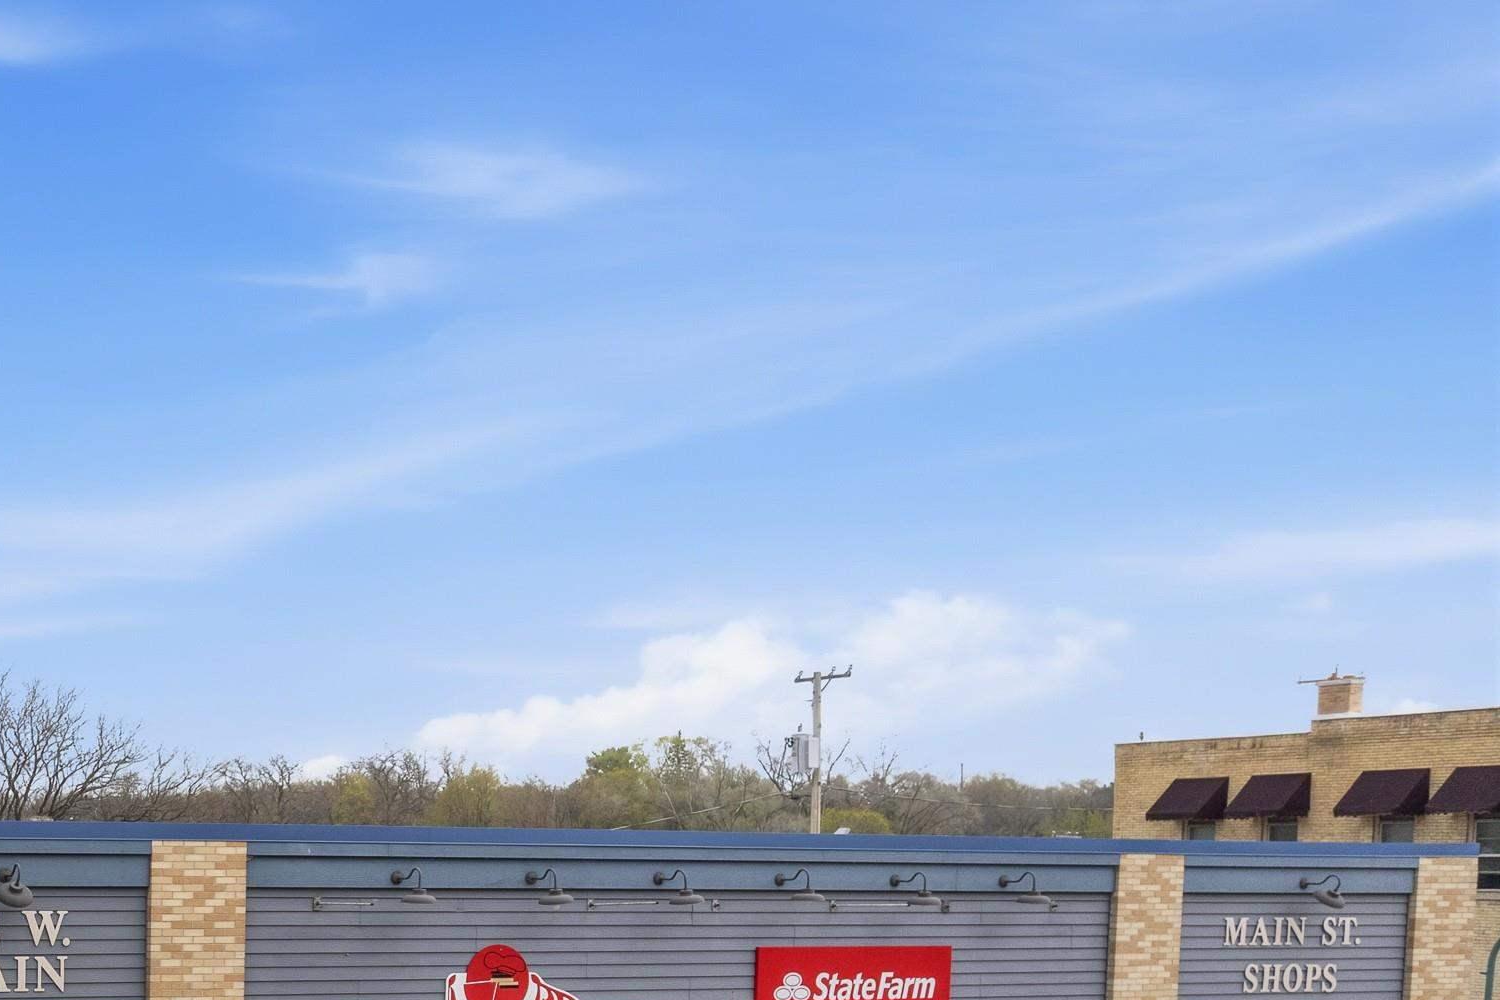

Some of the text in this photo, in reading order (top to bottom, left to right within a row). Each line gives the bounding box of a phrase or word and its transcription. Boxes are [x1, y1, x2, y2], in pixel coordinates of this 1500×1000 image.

[21, 910, 71, 947] W.
[1222, 916, 1362, 946] MAIN ST.
[1243, 963, 1338, 993] SHOPS
